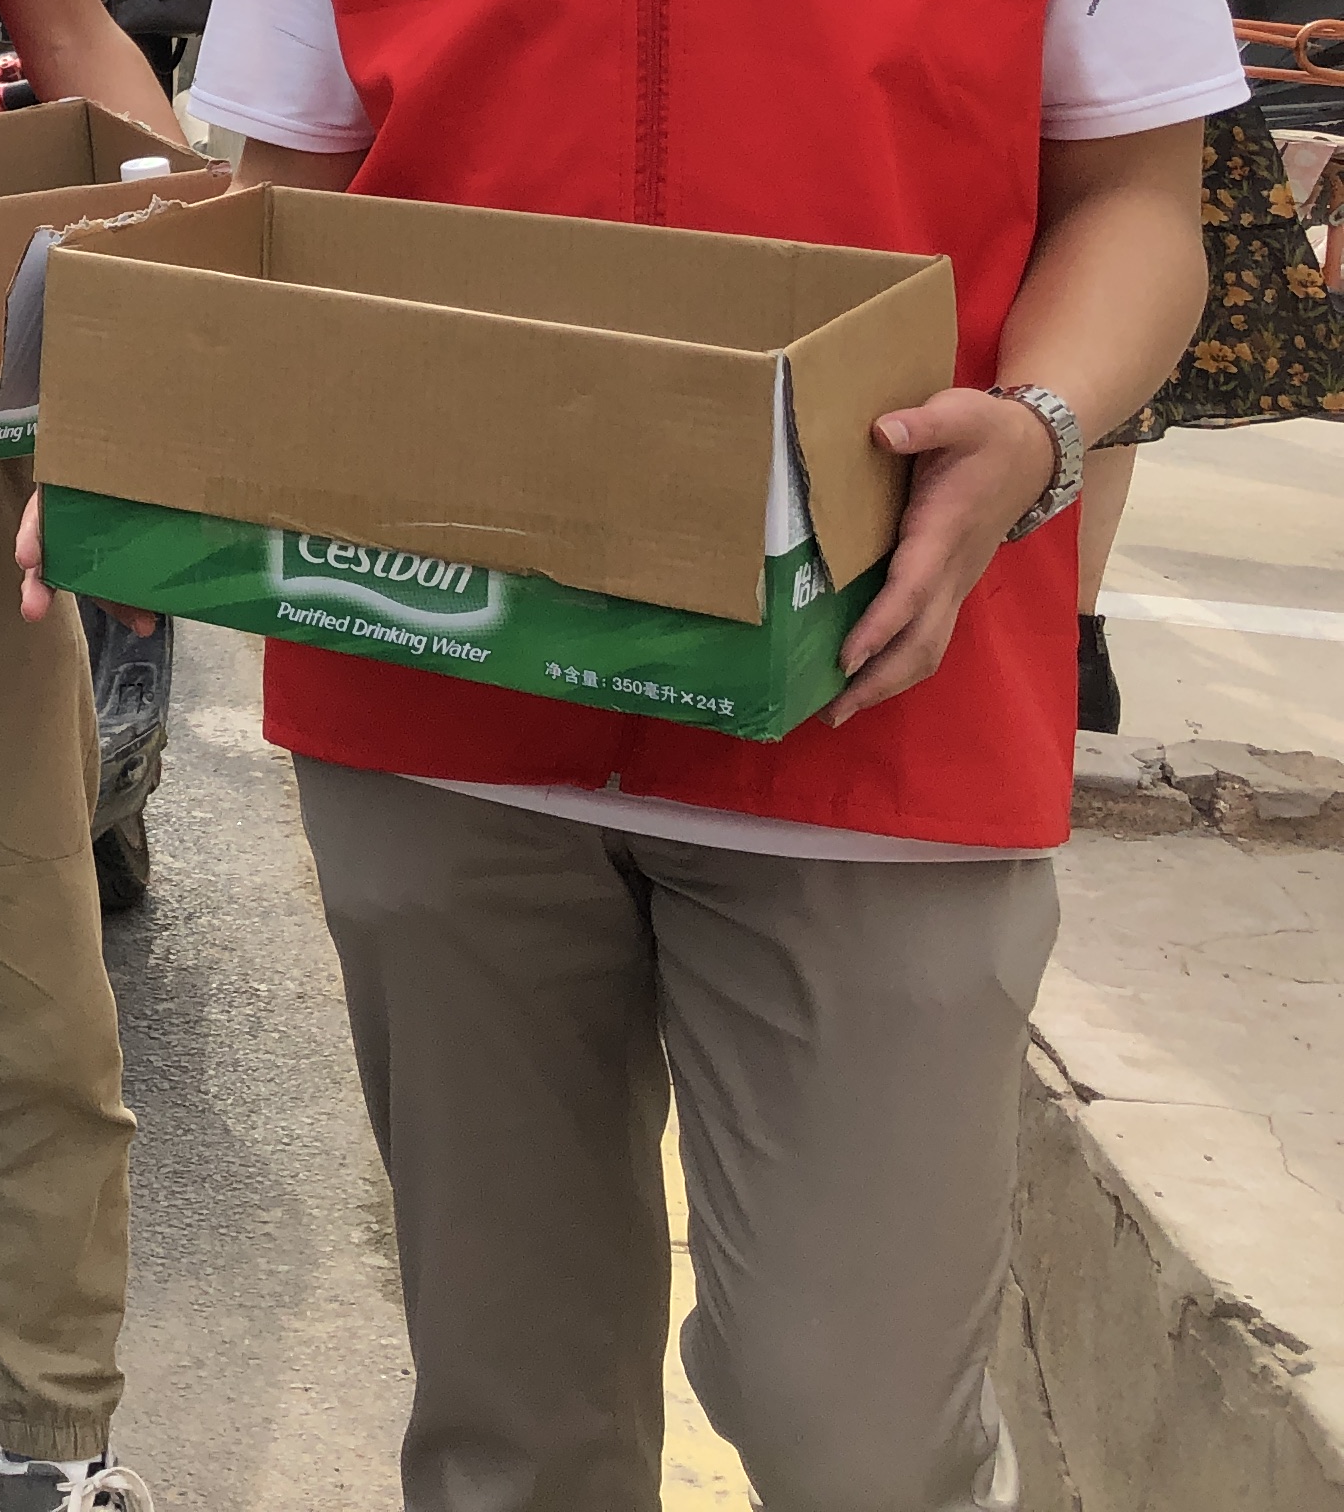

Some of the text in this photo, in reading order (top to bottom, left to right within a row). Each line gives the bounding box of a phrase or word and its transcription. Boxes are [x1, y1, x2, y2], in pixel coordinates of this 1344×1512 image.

[276, 601, 492, 664] Purified Drinking Water
